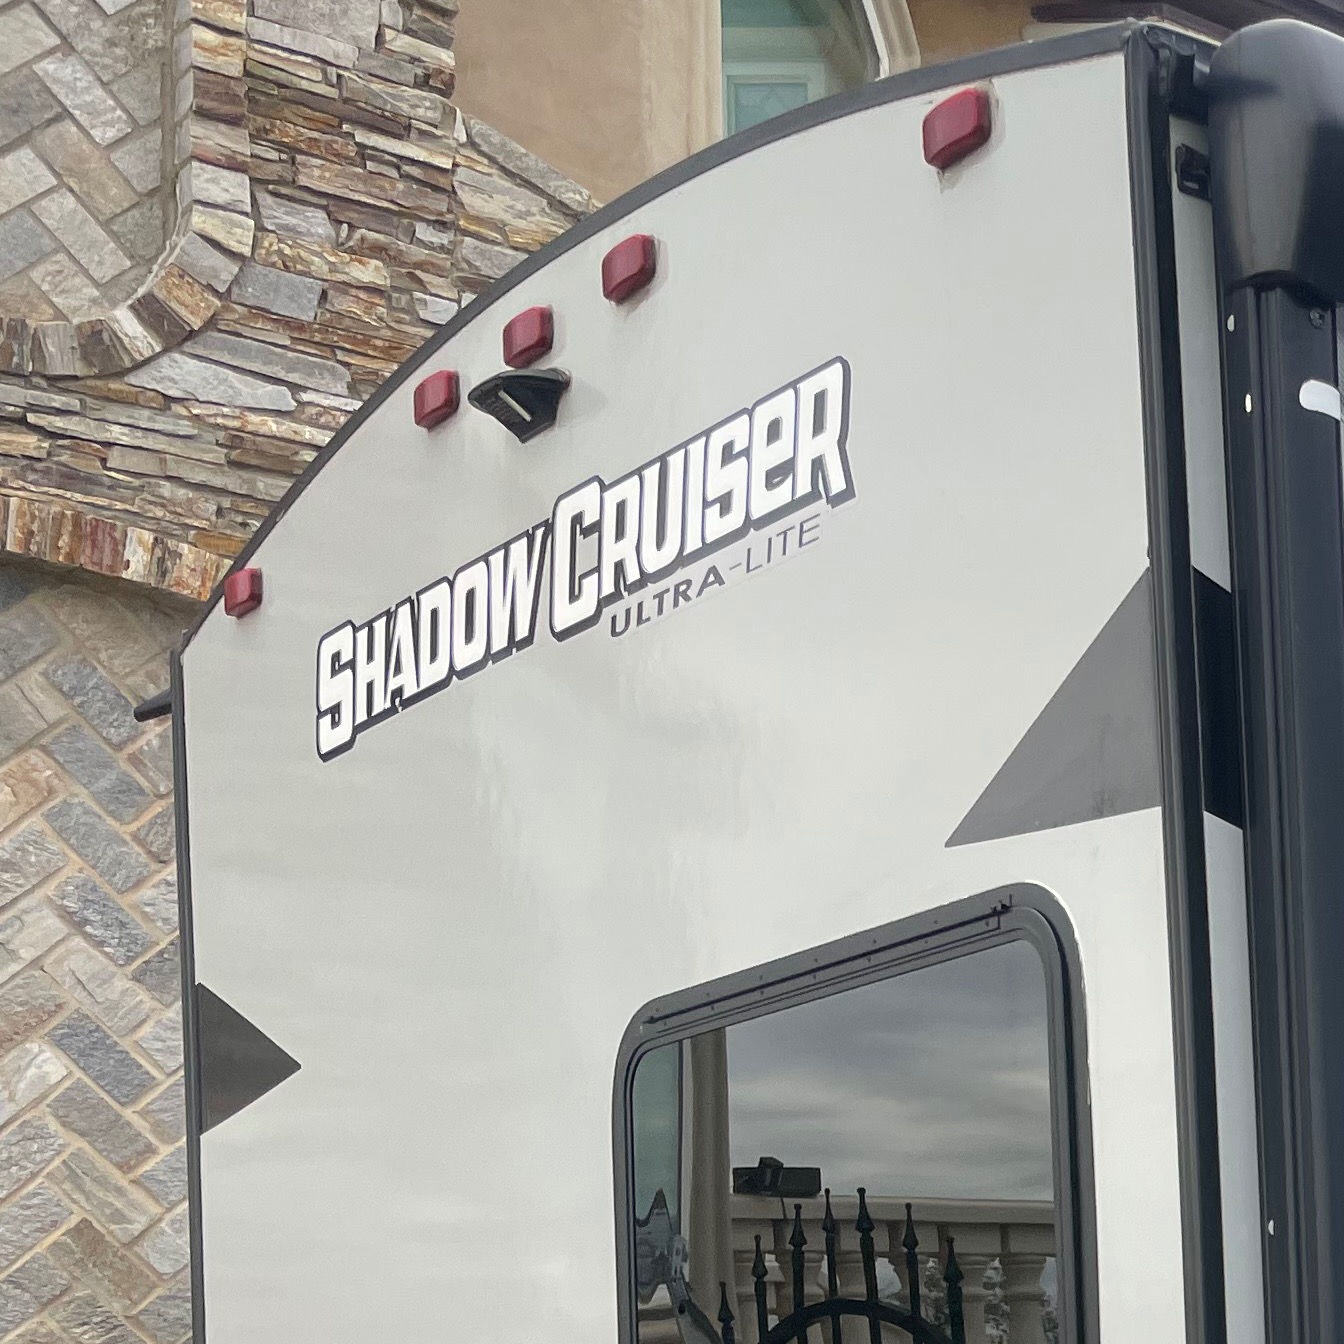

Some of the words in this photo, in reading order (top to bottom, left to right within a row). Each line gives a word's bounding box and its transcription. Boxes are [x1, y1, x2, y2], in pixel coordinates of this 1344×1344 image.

[317, 518, 551, 762] SHADOW
[551, 357, 856, 642] CRUISER
[610, 514, 821, 638] ULTRA-LITE
